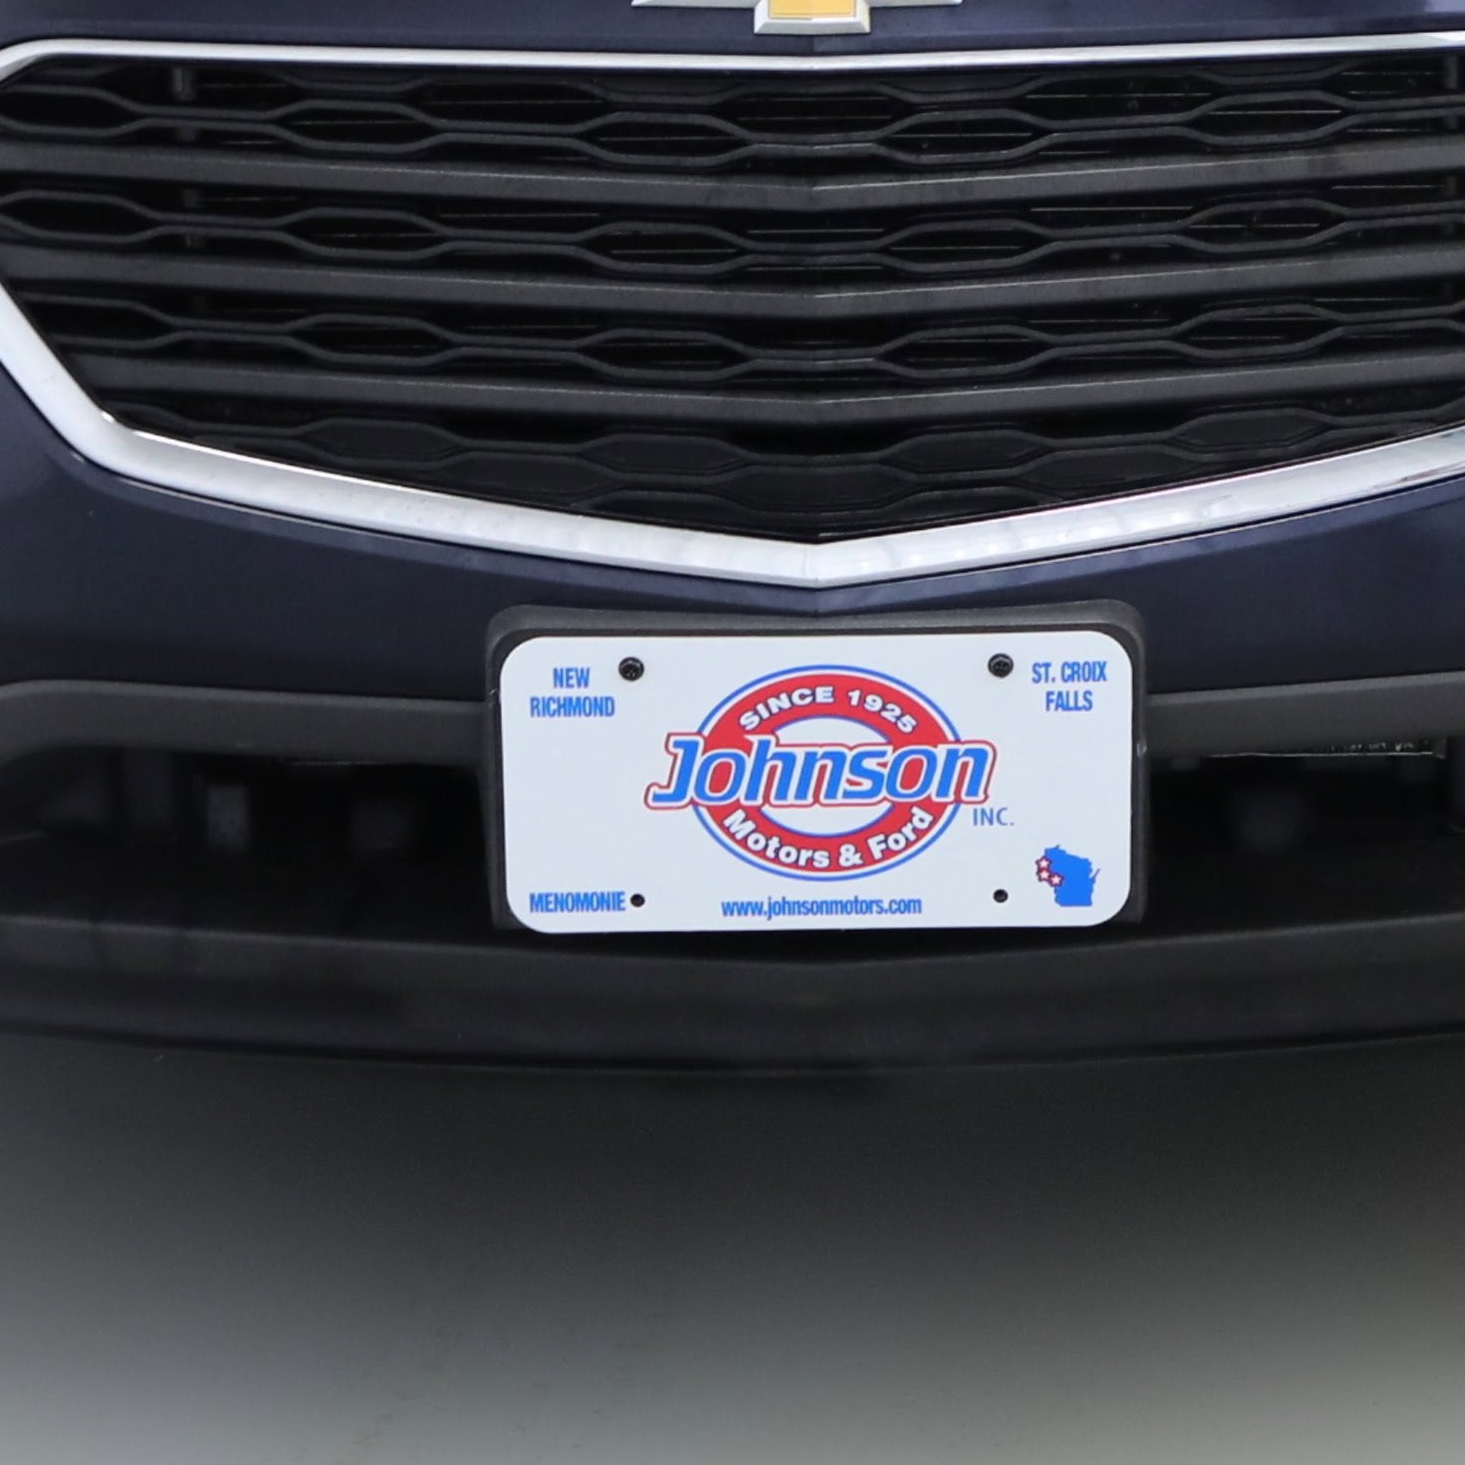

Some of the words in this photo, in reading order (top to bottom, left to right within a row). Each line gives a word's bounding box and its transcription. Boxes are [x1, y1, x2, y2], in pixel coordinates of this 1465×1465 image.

[552, 667, 591, 689] NEW
[1031, 662, 1056, 684] ST.
[1060, 661, 1108, 683] CROIX
[529, 696, 615, 718] RICHMOND
[739, 685, 835, 732] SINCE
[847, 688, 919, 734] 1925
[1045, 690, 1093, 712] FALLS
[648, 737, 992, 805] Johnson
[972, 807, 1015, 827] INC.
[722, 809, 831, 869] Motors
[838, 842, 864, 868] &
[866, 806, 934, 860] Ford
[529, 891, 627, 913] MENOMONIE
[721, 895, 922, 922] www.johnsonmotors.com
